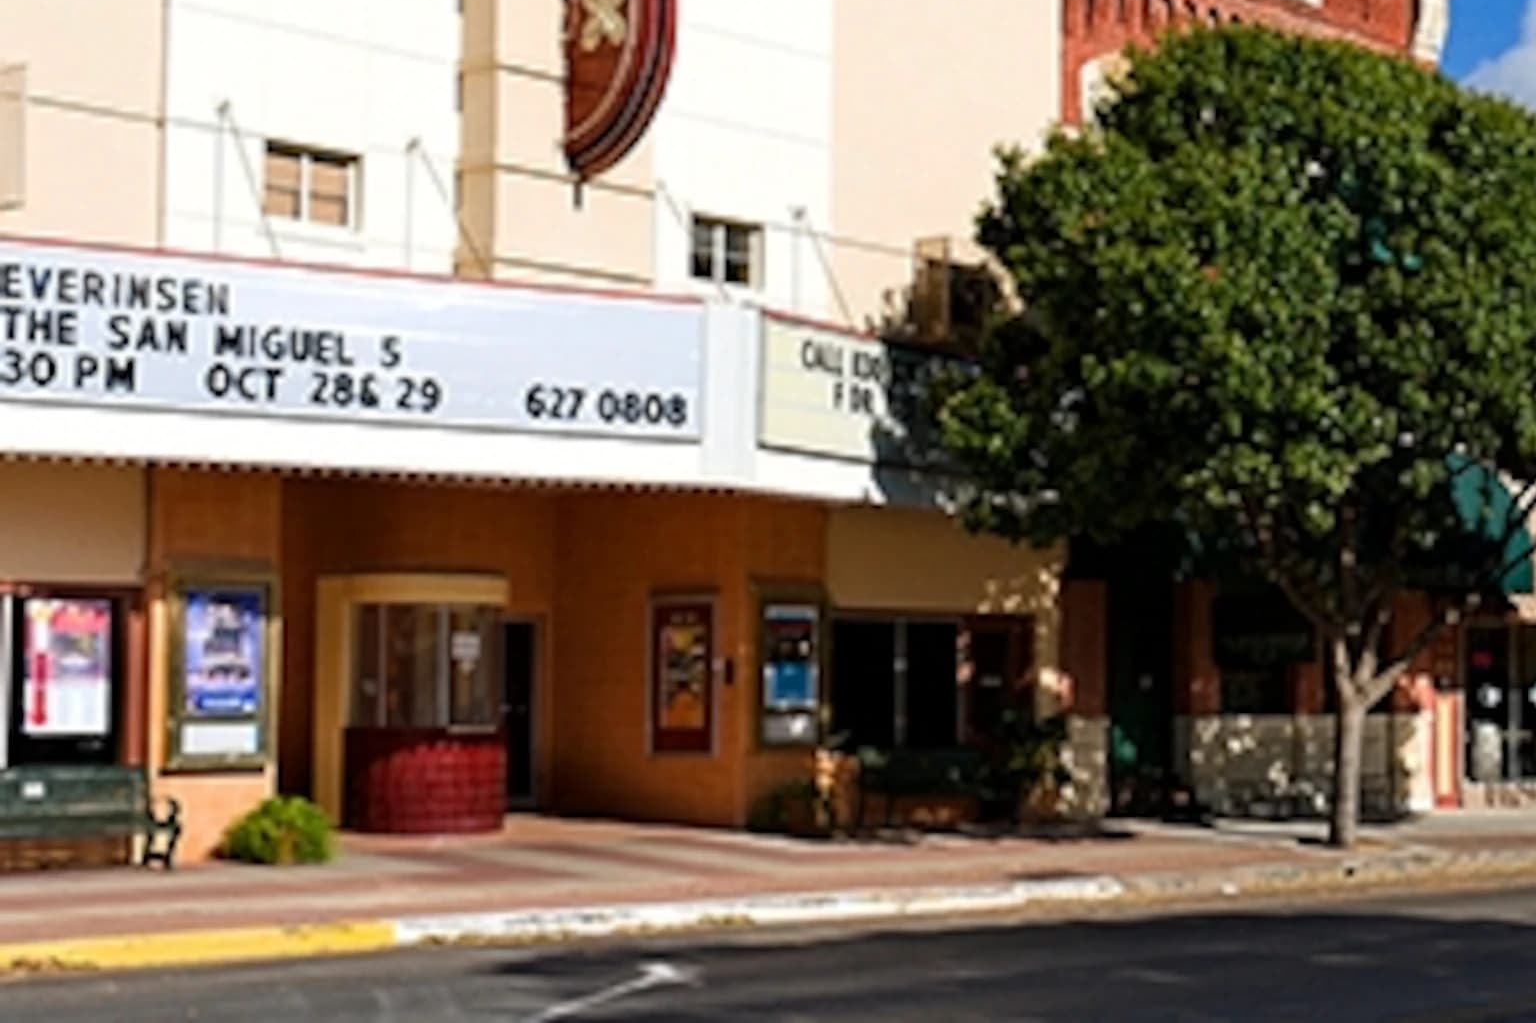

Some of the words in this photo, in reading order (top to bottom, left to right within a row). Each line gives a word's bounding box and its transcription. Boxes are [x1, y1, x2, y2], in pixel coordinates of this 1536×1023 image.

[0, 263, 229, 315] EVERINSEN
[0, 305, 77, 346] THE
[108, 314, 187, 353] SAN
[214, 324, 354, 367] MIGUEL
[1, 347, 56, 387] 30
[74, 353, 135, 393] PM
[206, 362, 283, 402] OCT
[397, 377, 441, 413] 29
[526, 383, 586, 419] 627
[598, 388, 687, 427] 0808
